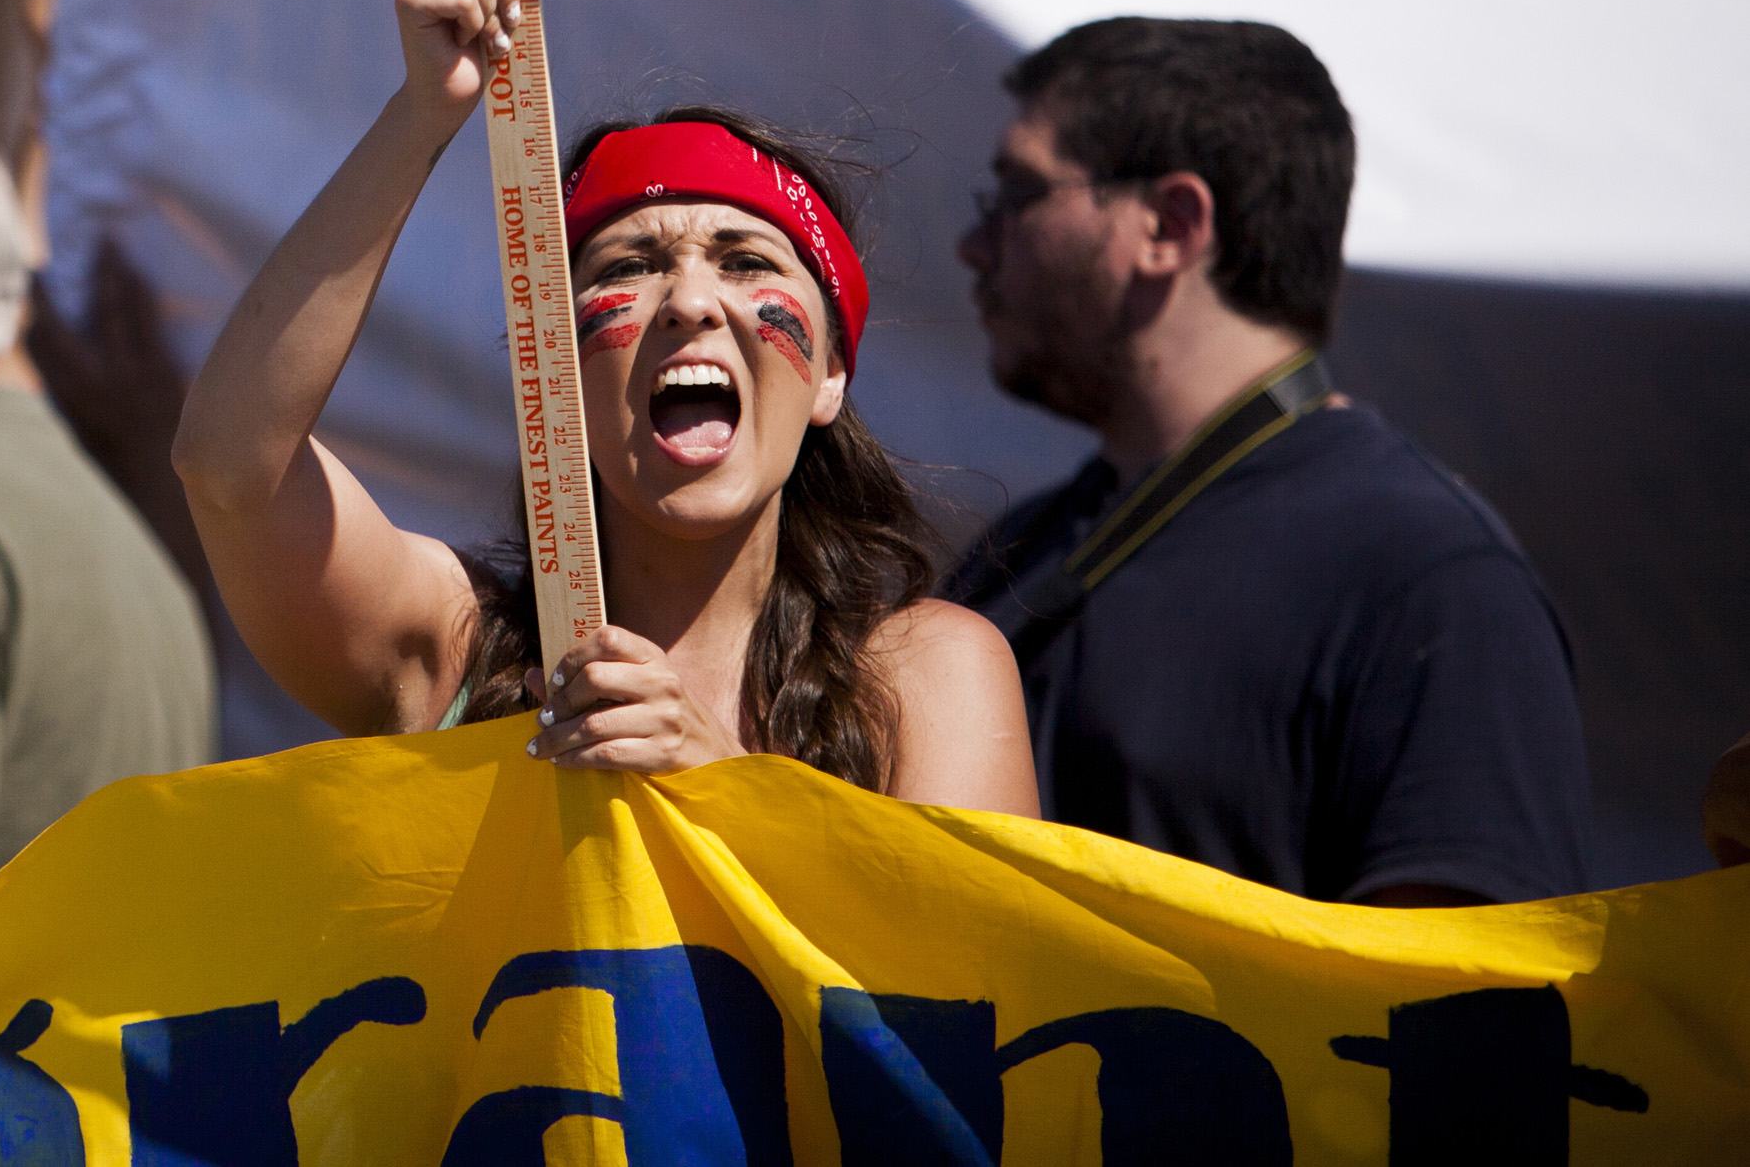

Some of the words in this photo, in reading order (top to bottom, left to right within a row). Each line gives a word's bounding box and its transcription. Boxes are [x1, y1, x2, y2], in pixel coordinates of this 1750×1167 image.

[514, 41, 527, 60] 14
[488, 51, 516, 123] POT
[519, 89, 532, 108] 15
[523, 138, 537, 157] 16
[528, 186, 542, 205] 17
[502, 185, 529, 268] HOME
[533, 234, 547, 253] 18
[510, 274, 533, 310] OF
[538, 283, 552, 301] 19
[515, 316, 539, 371] THE
[543, 330, 557, 349] 20
[548, 378, 561, 397] 21
[521, 376, 549, 473] FINEST
[553, 426, 566, 445] 22
[558, 474, 571, 493] 23
[531, 479, 559, 575] PAINTS
[563, 522, 577, 542] 24
[568, 570, 582, 590] 25
[573, 618, 587, 638] 26
